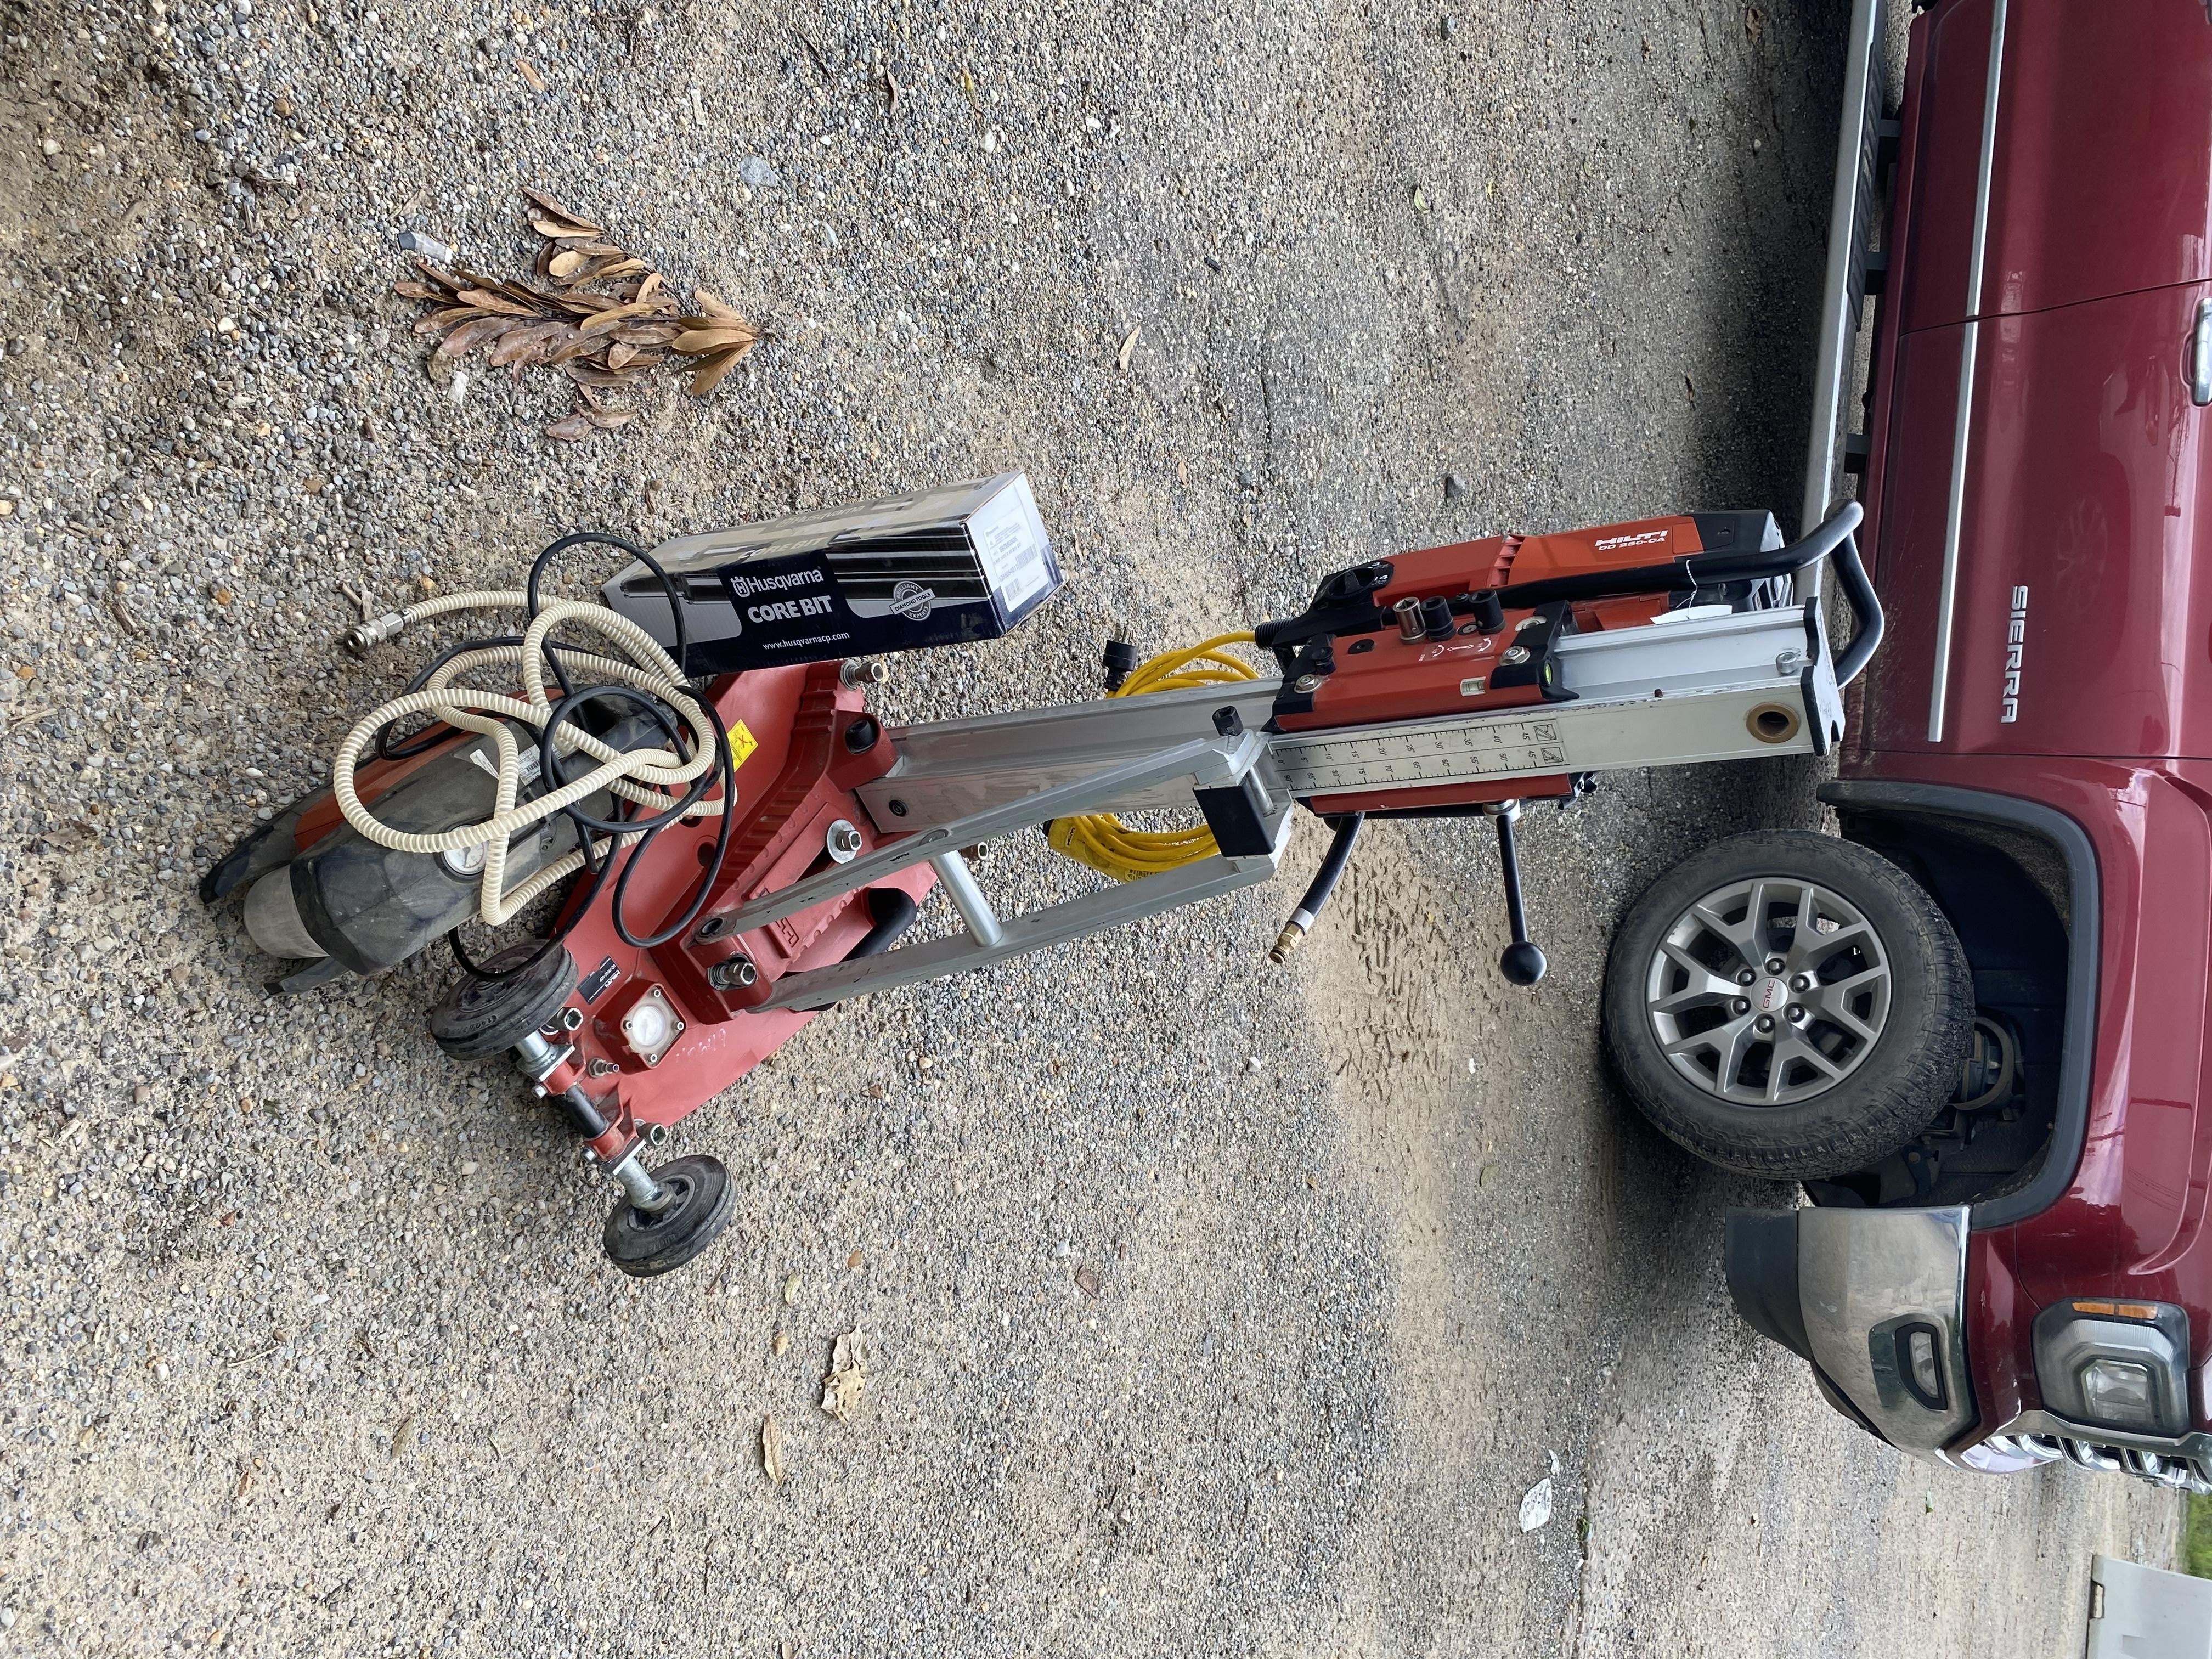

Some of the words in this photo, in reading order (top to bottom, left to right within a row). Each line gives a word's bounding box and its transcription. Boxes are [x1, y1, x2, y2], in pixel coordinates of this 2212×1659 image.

[1595, 529, 1668, 546] HILTI
[1618, 537, 1665, 548] 250-CA
[746, 568, 824, 594] Husqvarna
[896, 583, 919, 599] BRILLIANT
[747, 600, 802, 623] CORE
[799, 595, 833, 617] BIT
[894, 598, 916, 611] DIAMOND
[915, 592, 931, 602] TOOLS
[909, 605, 929, 618] EXPERTS
[763, 632, 850, 650] www.husqvarnacp.com
[2001, 585, 2028, 723] SIERRA
[1067, 827, 1075, 847] HILTI
[1763, 979, 1776, 1008] GMC
